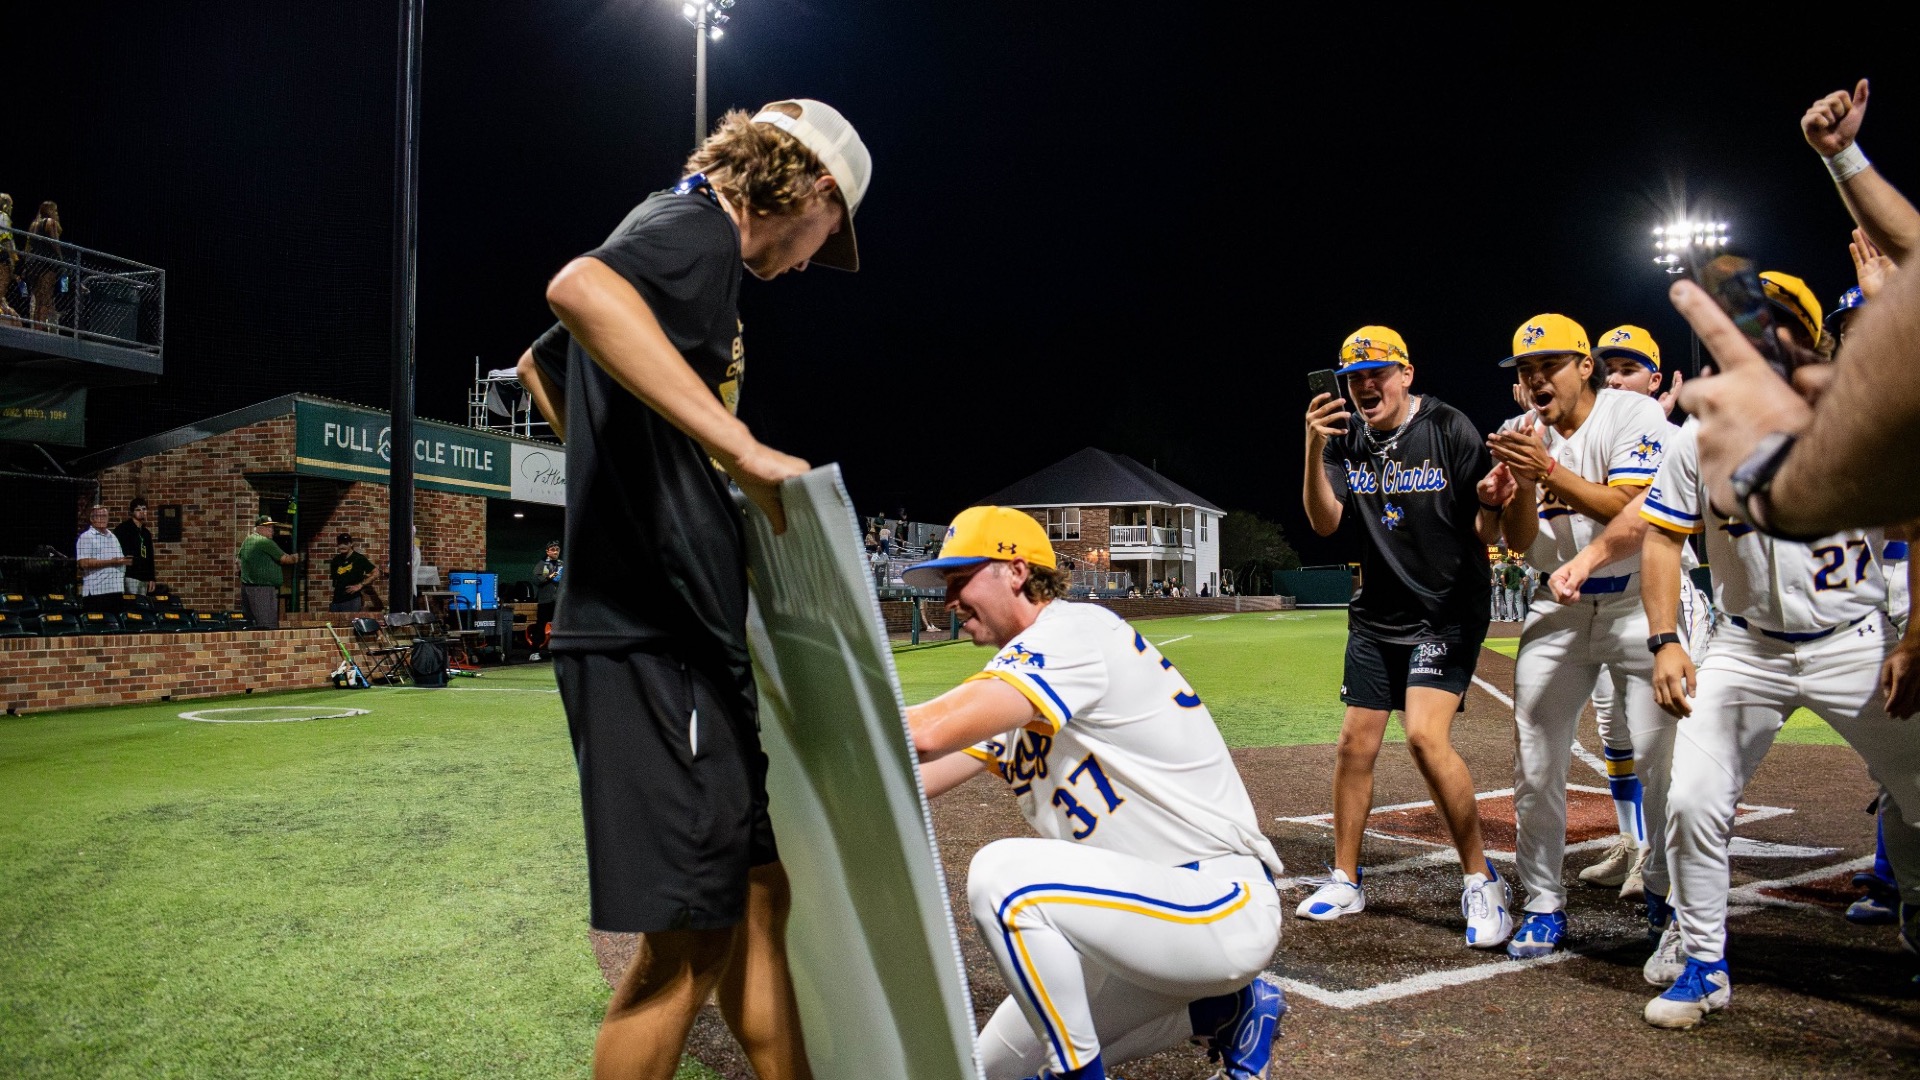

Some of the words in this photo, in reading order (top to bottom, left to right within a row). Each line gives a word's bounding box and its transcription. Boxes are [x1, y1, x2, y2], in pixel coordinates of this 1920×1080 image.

[324, 422, 374, 453] FULL
[450, 444, 493, 471] TITLE
[1382, 459, 1448, 494] Charles
[1812, 534, 1873, 593] 27
[1052, 751, 1127, 841] 37
